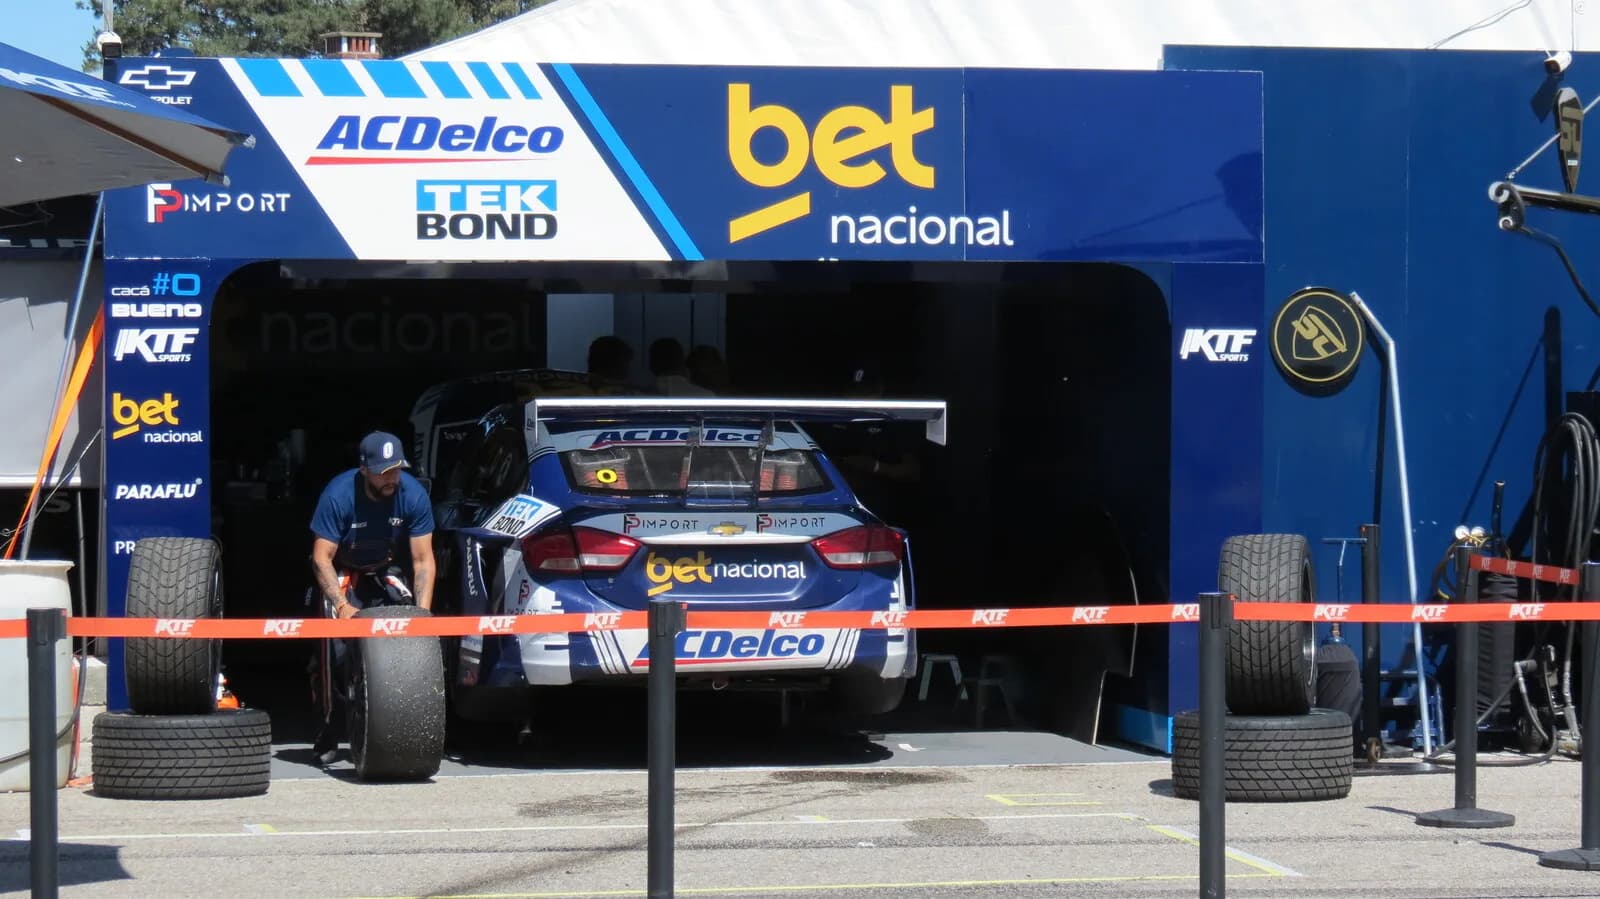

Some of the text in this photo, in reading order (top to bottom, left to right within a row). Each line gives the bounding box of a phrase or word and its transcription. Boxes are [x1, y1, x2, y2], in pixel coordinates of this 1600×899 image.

[316, 115, 564, 153] ACDelco
[728, 83, 934, 188] bet
[422, 183, 552, 211] TEK
[417, 213, 557, 240] BOND
[831, 206, 1014, 246] nacional
[259, 297, 534, 352] nacional
[114, 328, 200, 362] KTF
[1180, 329, 1257, 361] KTF
[112, 392, 179, 425] bet
[144, 430, 203, 443] nacional
[492, 515, 526, 535] BOND
[115, 541, 137, 555] PR
[646, 551, 807, 584] bet nacional
[1172, 603, 1199, 620] KT
